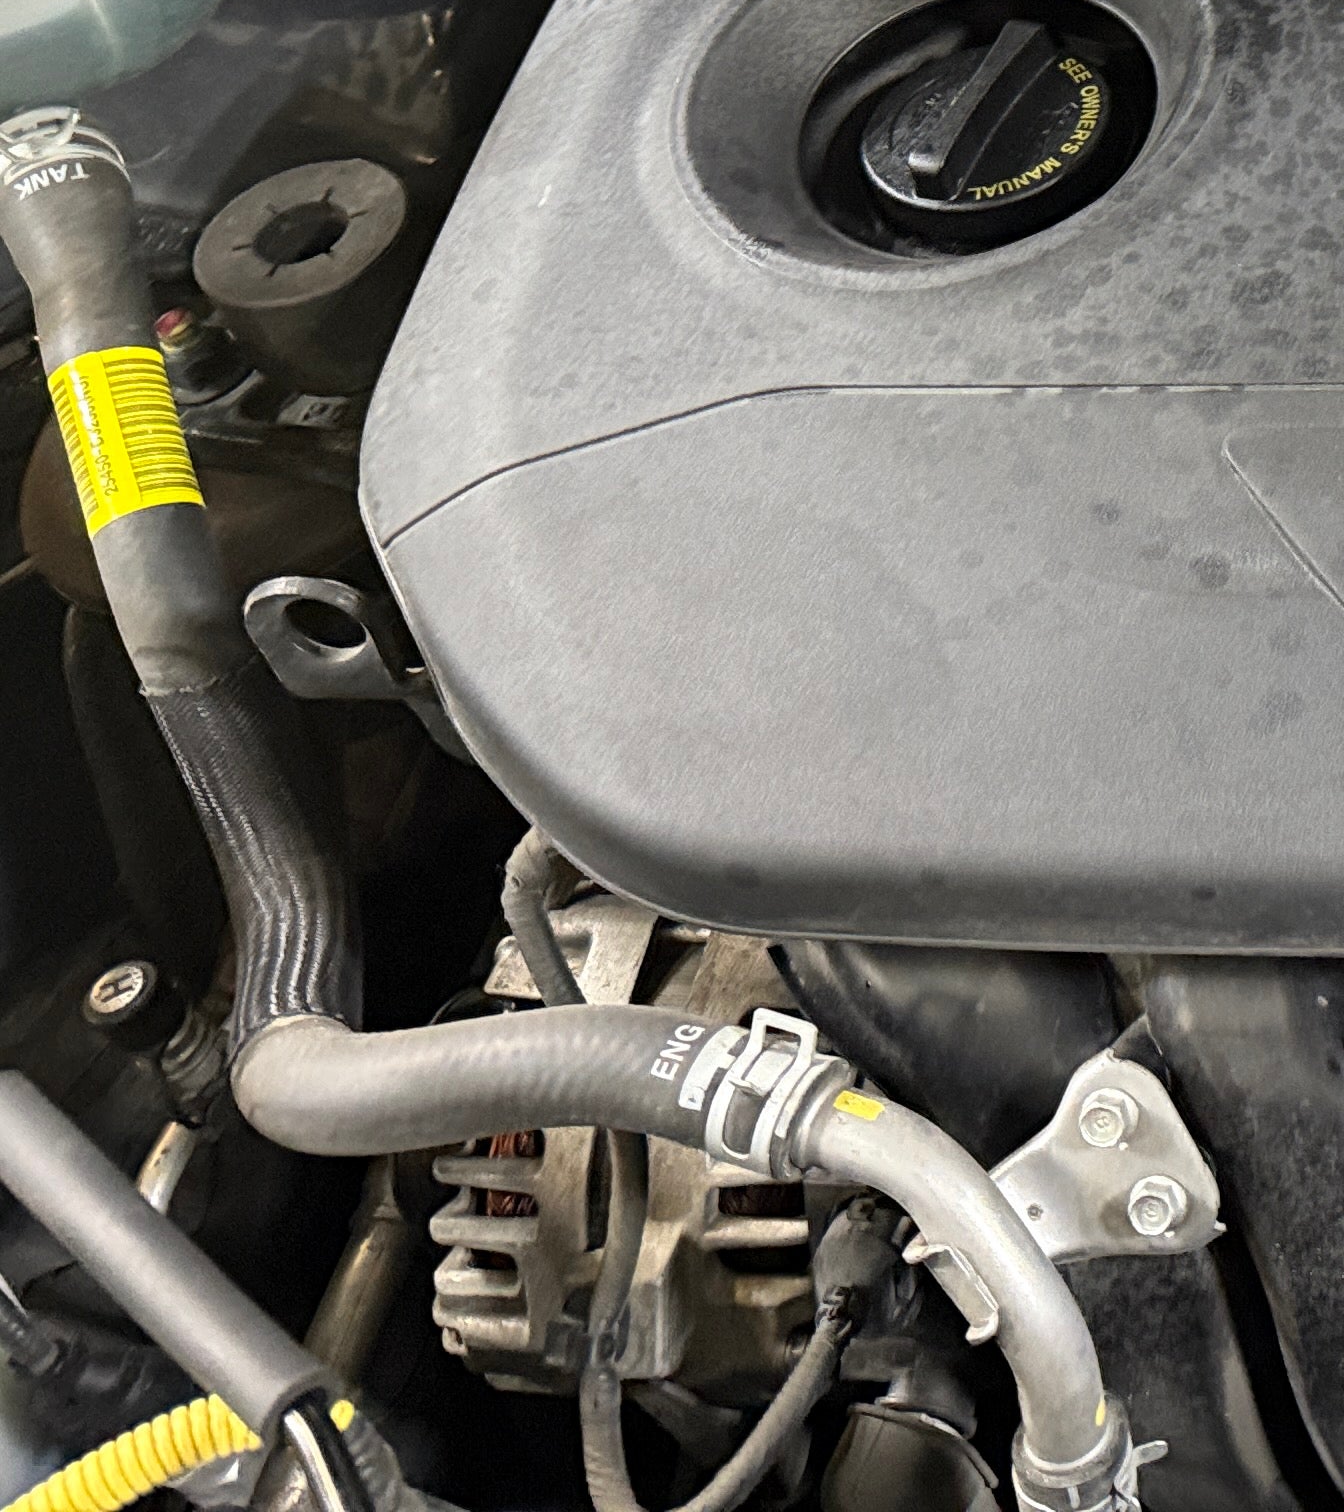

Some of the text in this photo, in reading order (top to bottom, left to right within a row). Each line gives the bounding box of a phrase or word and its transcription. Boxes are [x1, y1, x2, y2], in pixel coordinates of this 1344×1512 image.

[966, 57, 1101, 200] SEE OWNER'S MANUAL
[13, 162, 90, 201] TANK
[650, 1024, 706, 1081] ENG
